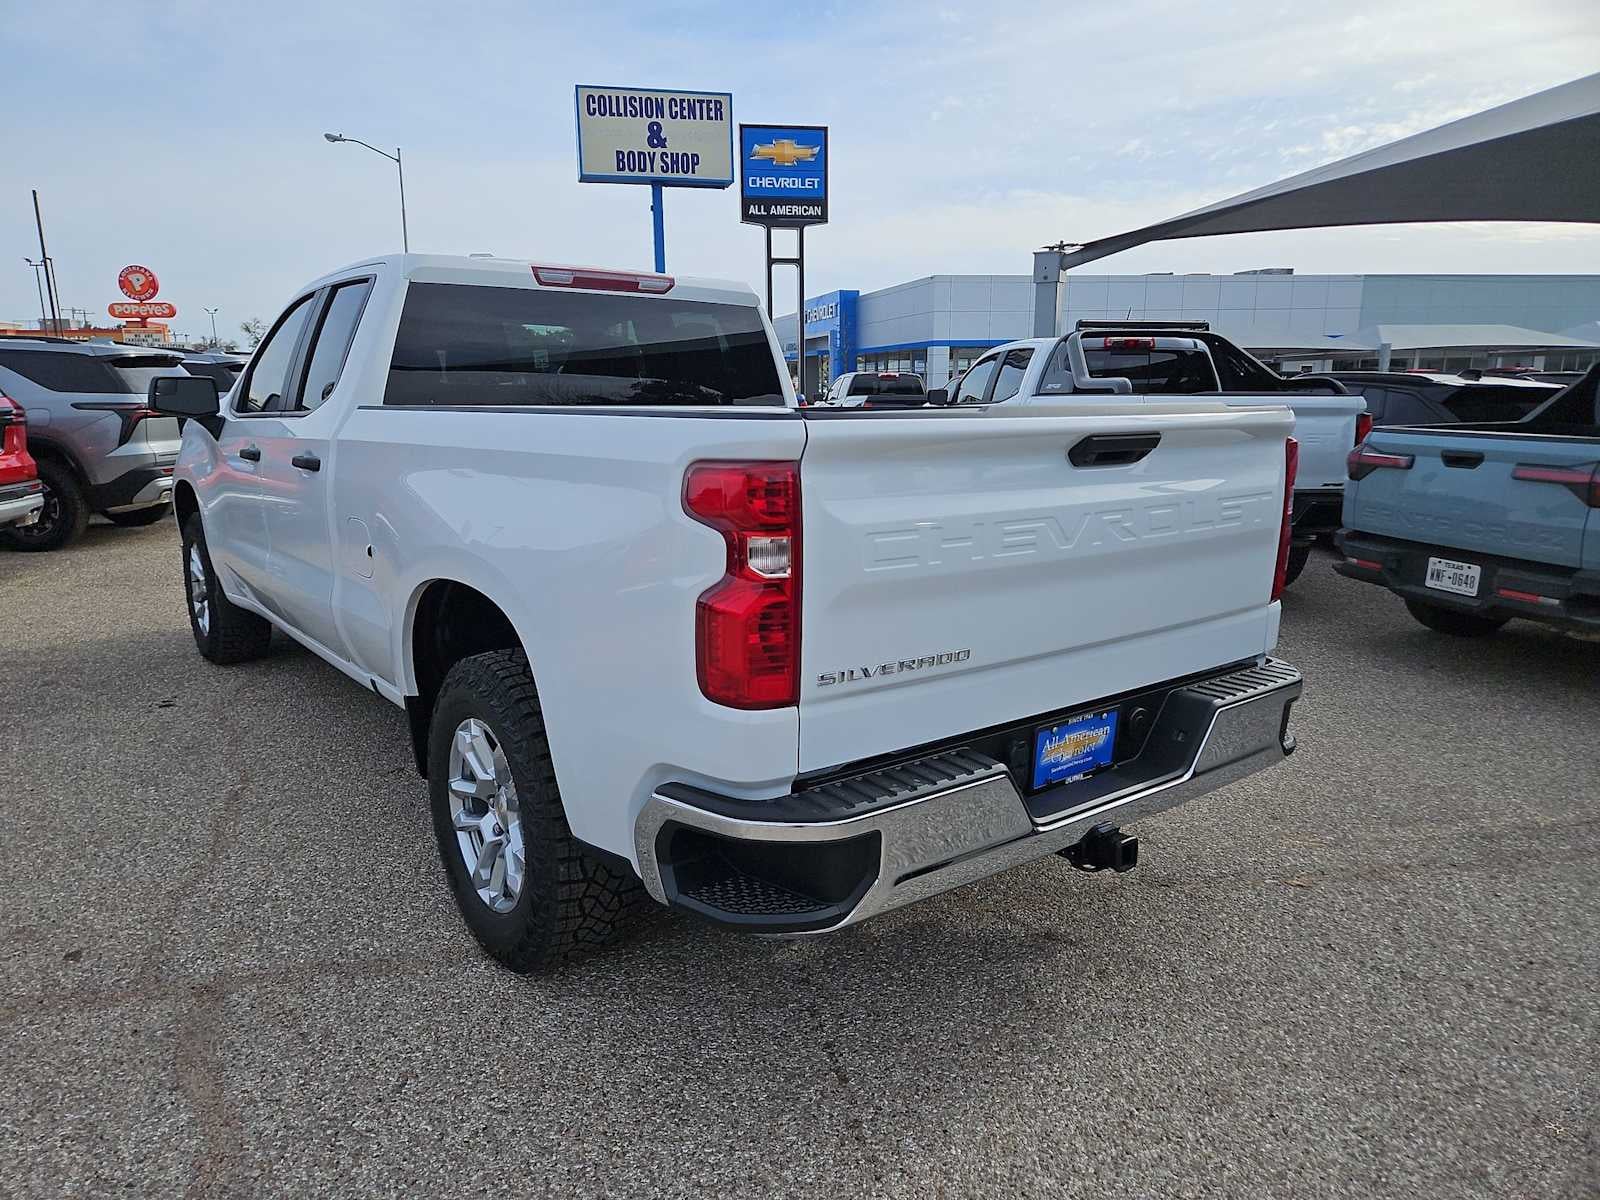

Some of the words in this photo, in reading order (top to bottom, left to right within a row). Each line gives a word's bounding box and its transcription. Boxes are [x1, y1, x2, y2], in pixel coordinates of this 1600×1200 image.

[585, 94, 665, 119] COLLISION
[668, 97, 724, 121] CENTER
[646, 121, 668, 149] &
[615, 150, 656, 173] BODY
[660, 152, 700, 175] SHOP
[748, 176, 820, 189] CHEVROLET
[748, 204, 767, 215] ALL
[769, 205, 822, 216] AMERICAN
[863, 490, 1273, 572] CHEVROLET
[816, 648, 972, 687] SILVERADO
